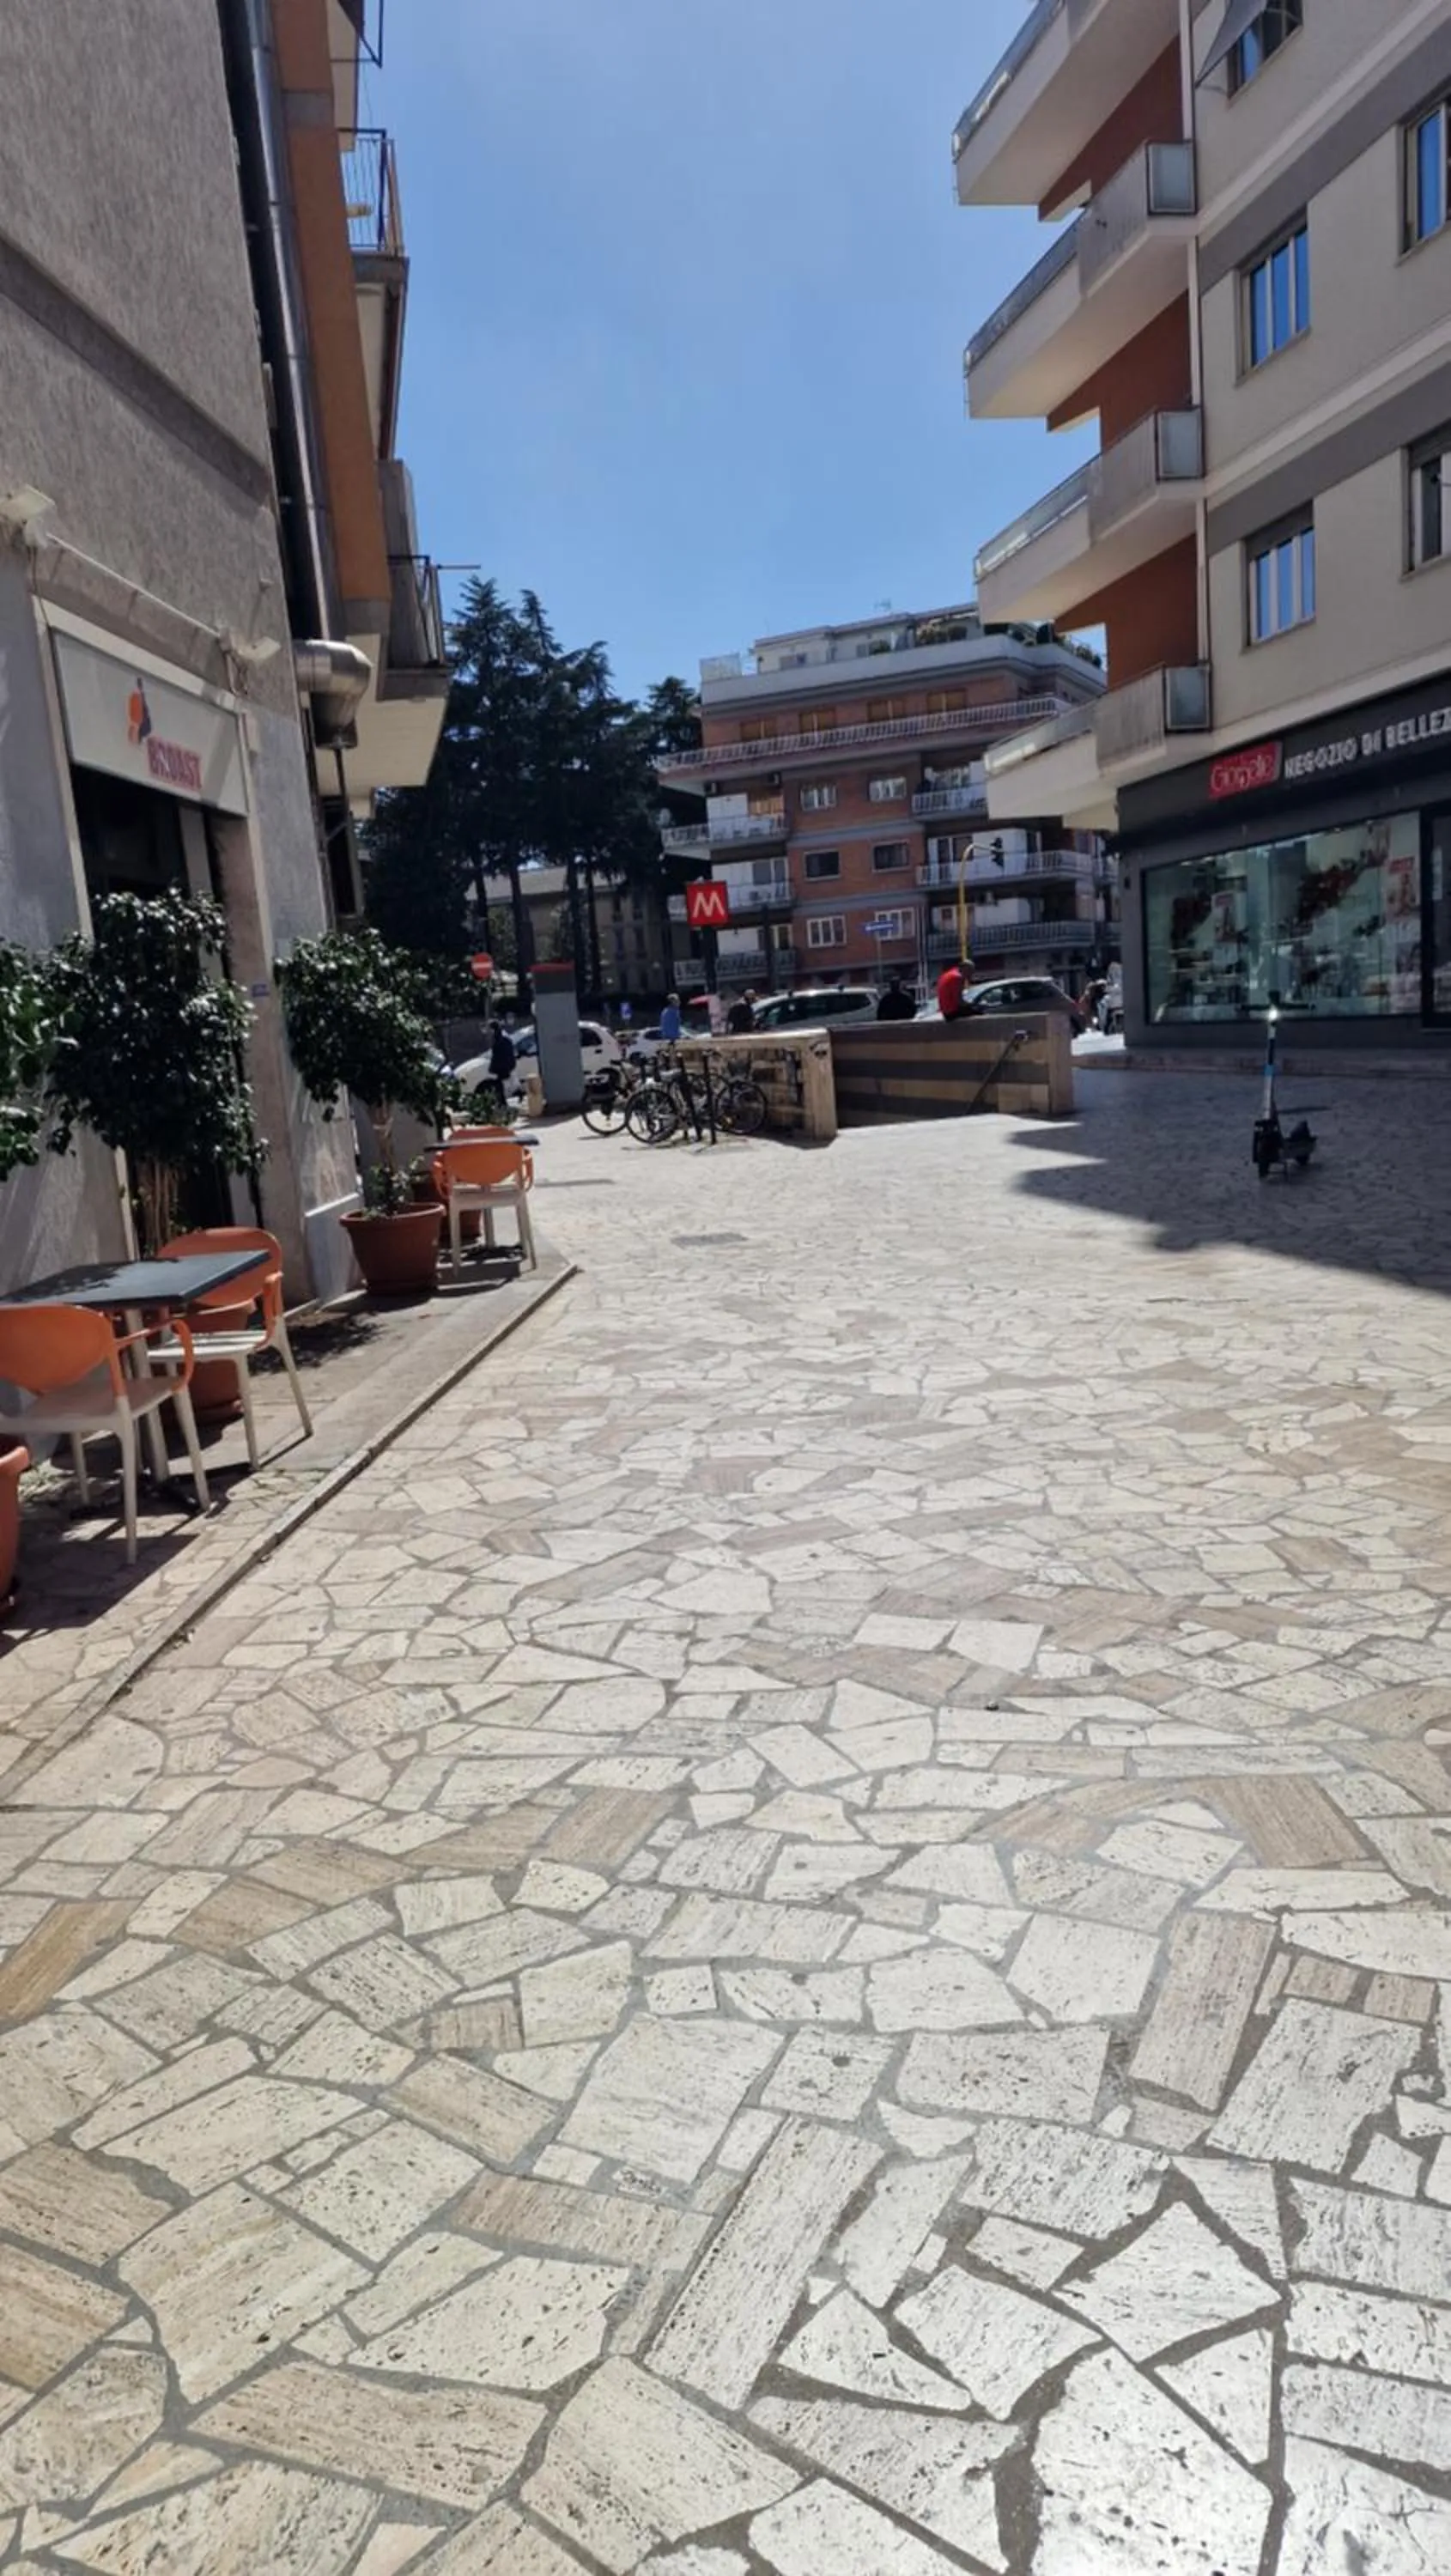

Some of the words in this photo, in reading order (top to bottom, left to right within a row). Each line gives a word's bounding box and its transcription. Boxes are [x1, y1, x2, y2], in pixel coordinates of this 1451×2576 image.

[1284, 736, 1357, 779] NEGOZIO
[1362, 729, 1382, 756] DI
[692, 890, 726, 918] M
